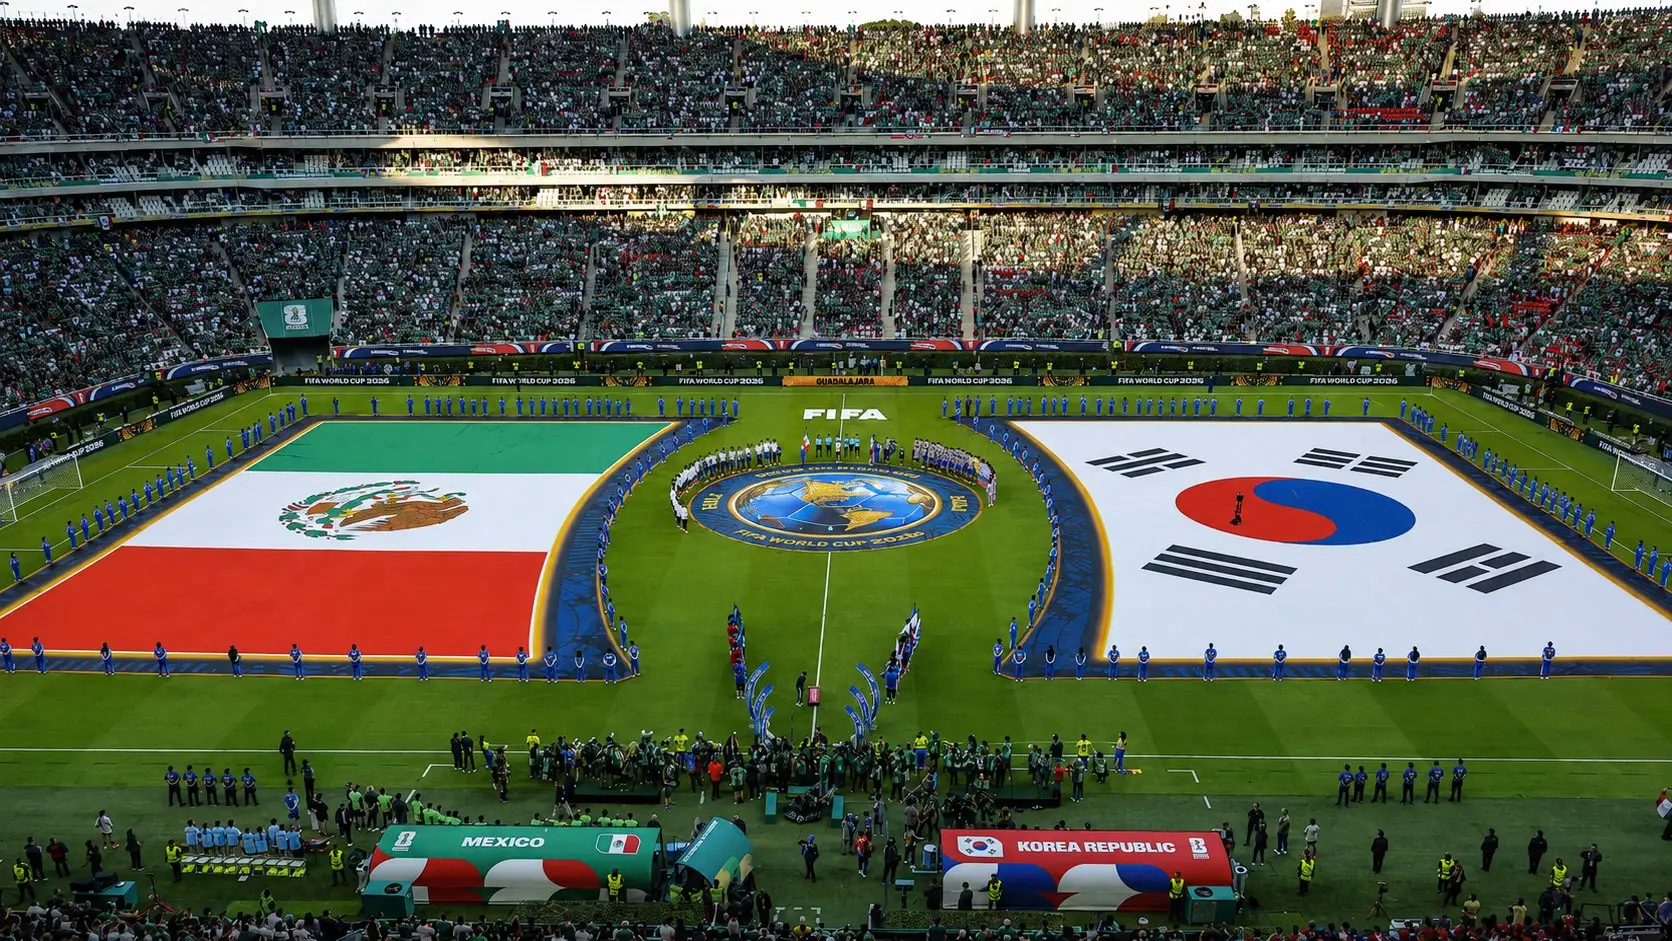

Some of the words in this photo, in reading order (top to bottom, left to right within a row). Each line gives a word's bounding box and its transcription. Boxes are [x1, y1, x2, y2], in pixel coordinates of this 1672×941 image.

[803, 409, 888, 420] FIFA
[769, 536, 828, 547] WORLD
[461, 837, 545, 847] MEXICO
[1017, 841, 1081, 852] KOREA
[1084, 842, 1176, 853] REPUBLIC
